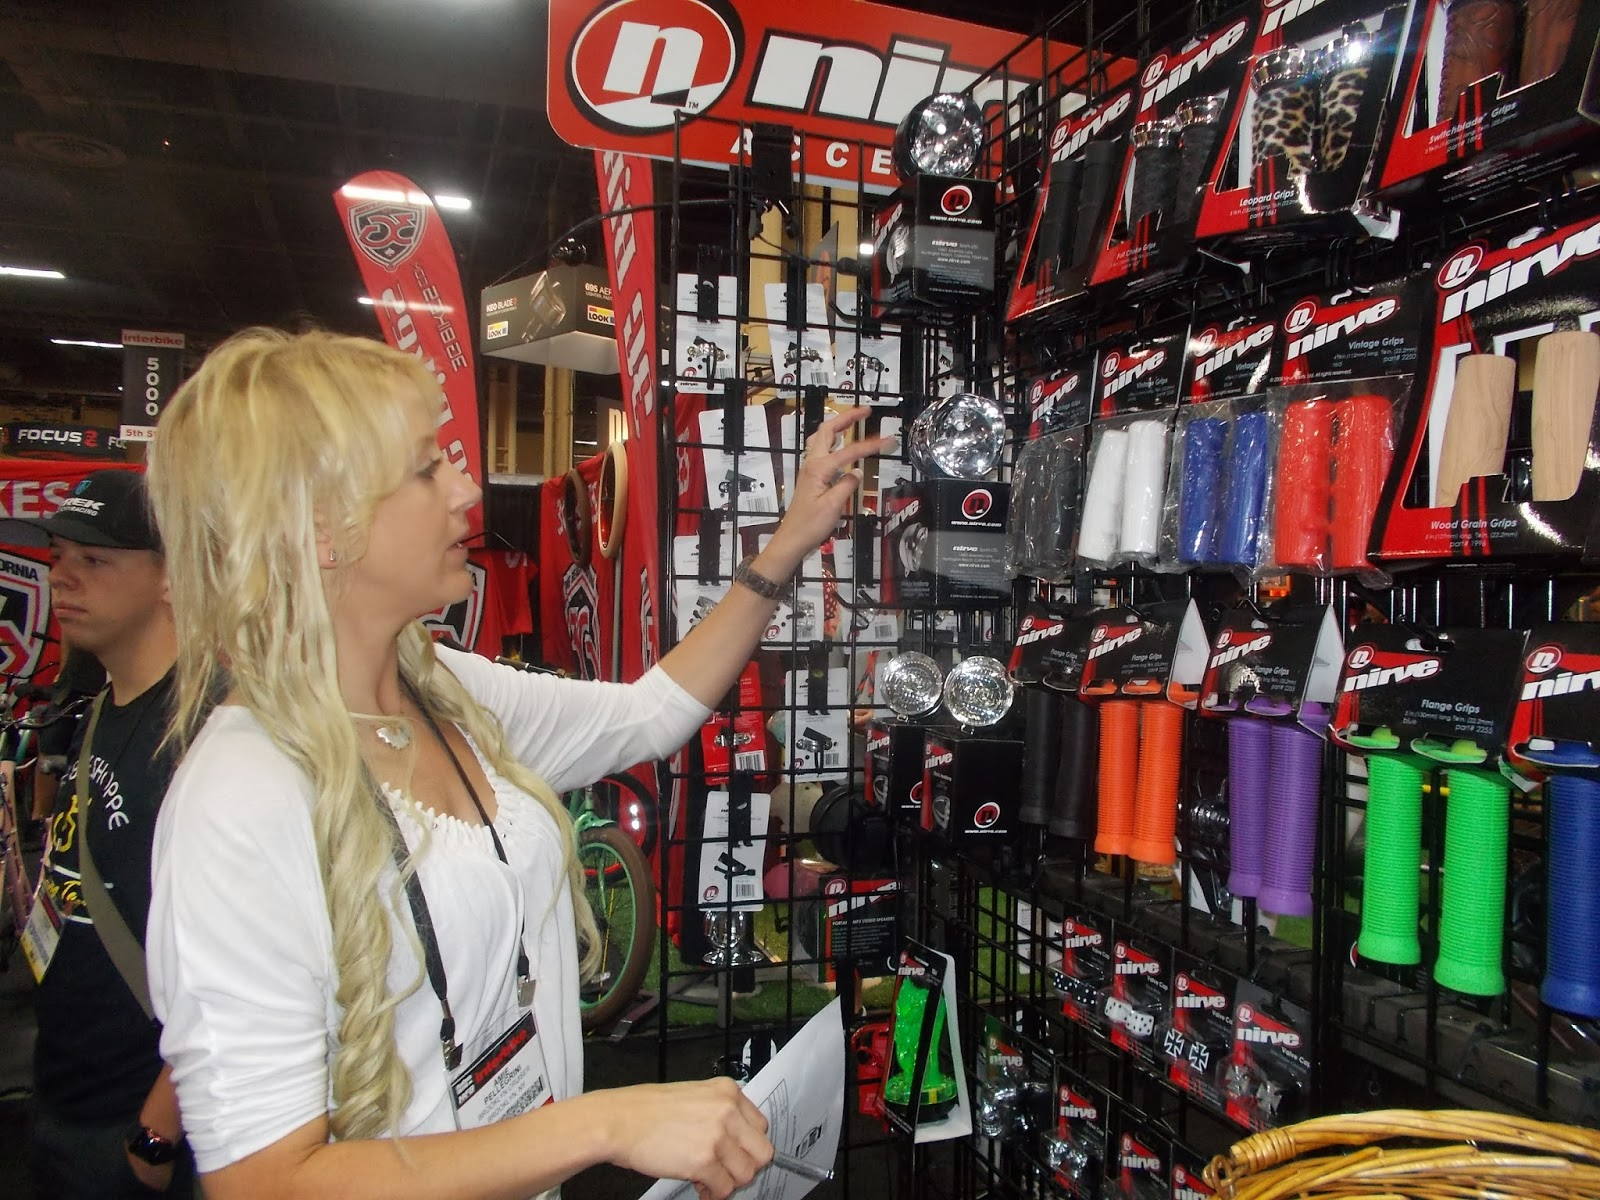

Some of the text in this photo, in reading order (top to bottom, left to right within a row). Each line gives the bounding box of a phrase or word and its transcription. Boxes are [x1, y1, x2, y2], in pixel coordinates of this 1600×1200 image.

[1141, 21, 1246, 112] nirve
[1491, 102, 1518, 119] Grips
[1051, 92, 1131, 164] nirve
[1240, 189, 1295, 207] Leopard Grips
[585, 283, 598, 293] 695
[588, 313, 610, 323] LOOK
[1287, 299, 1397, 361] nirve
[123, 333, 184, 346] interbike
[1348, 336, 1405, 350] Vintage Grips
[1195, 324, 1274, 382] nirve
[1103, 350, 1165, 400] nirve
[1032, 374, 1079, 423] nirve
[18, 428, 83, 443] FOCUS
[125, 428, 144, 438] 5th
[884, 499, 920, 537] nirve
[1431, 518, 1518, 530] Wood Grain Grips
[1016, 623, 1064, 647] nirve
[1088, 627, 1143, 660] nirve
[1210, 634, 1271, 669] nirve
[1273, 666, 1290, 676] Grips
[1343, 659, 1440, 693] nirve
[1421, 699, 1481, 715] Flange Grips
[1455, 724, 1475, 732] part#
[1476, 726, 1493, 735] 2255
[866, 736, 890, 752] nirve
[924, 752, 953, 769] nirve
[1065, 933, 1102, 949] nirve
[898, 965, 926, 976] nirve
[1116, 961, 1160, 975] nirve
[1147, 975, 1159, 985] Valve
[1176, 993, 1226, 1009] nirve
[1237, 1027, 1300, 1046] nirve
[989, 1054, 1024, 1067] nirve
[1281, 1046, 1298, 1061] Valve
[484, 1065, 522, 1105] PELLEGRINI
[1060, 1104, 1098, 1119] nirve
[1121, 1154, 1161, 1170] nirve
